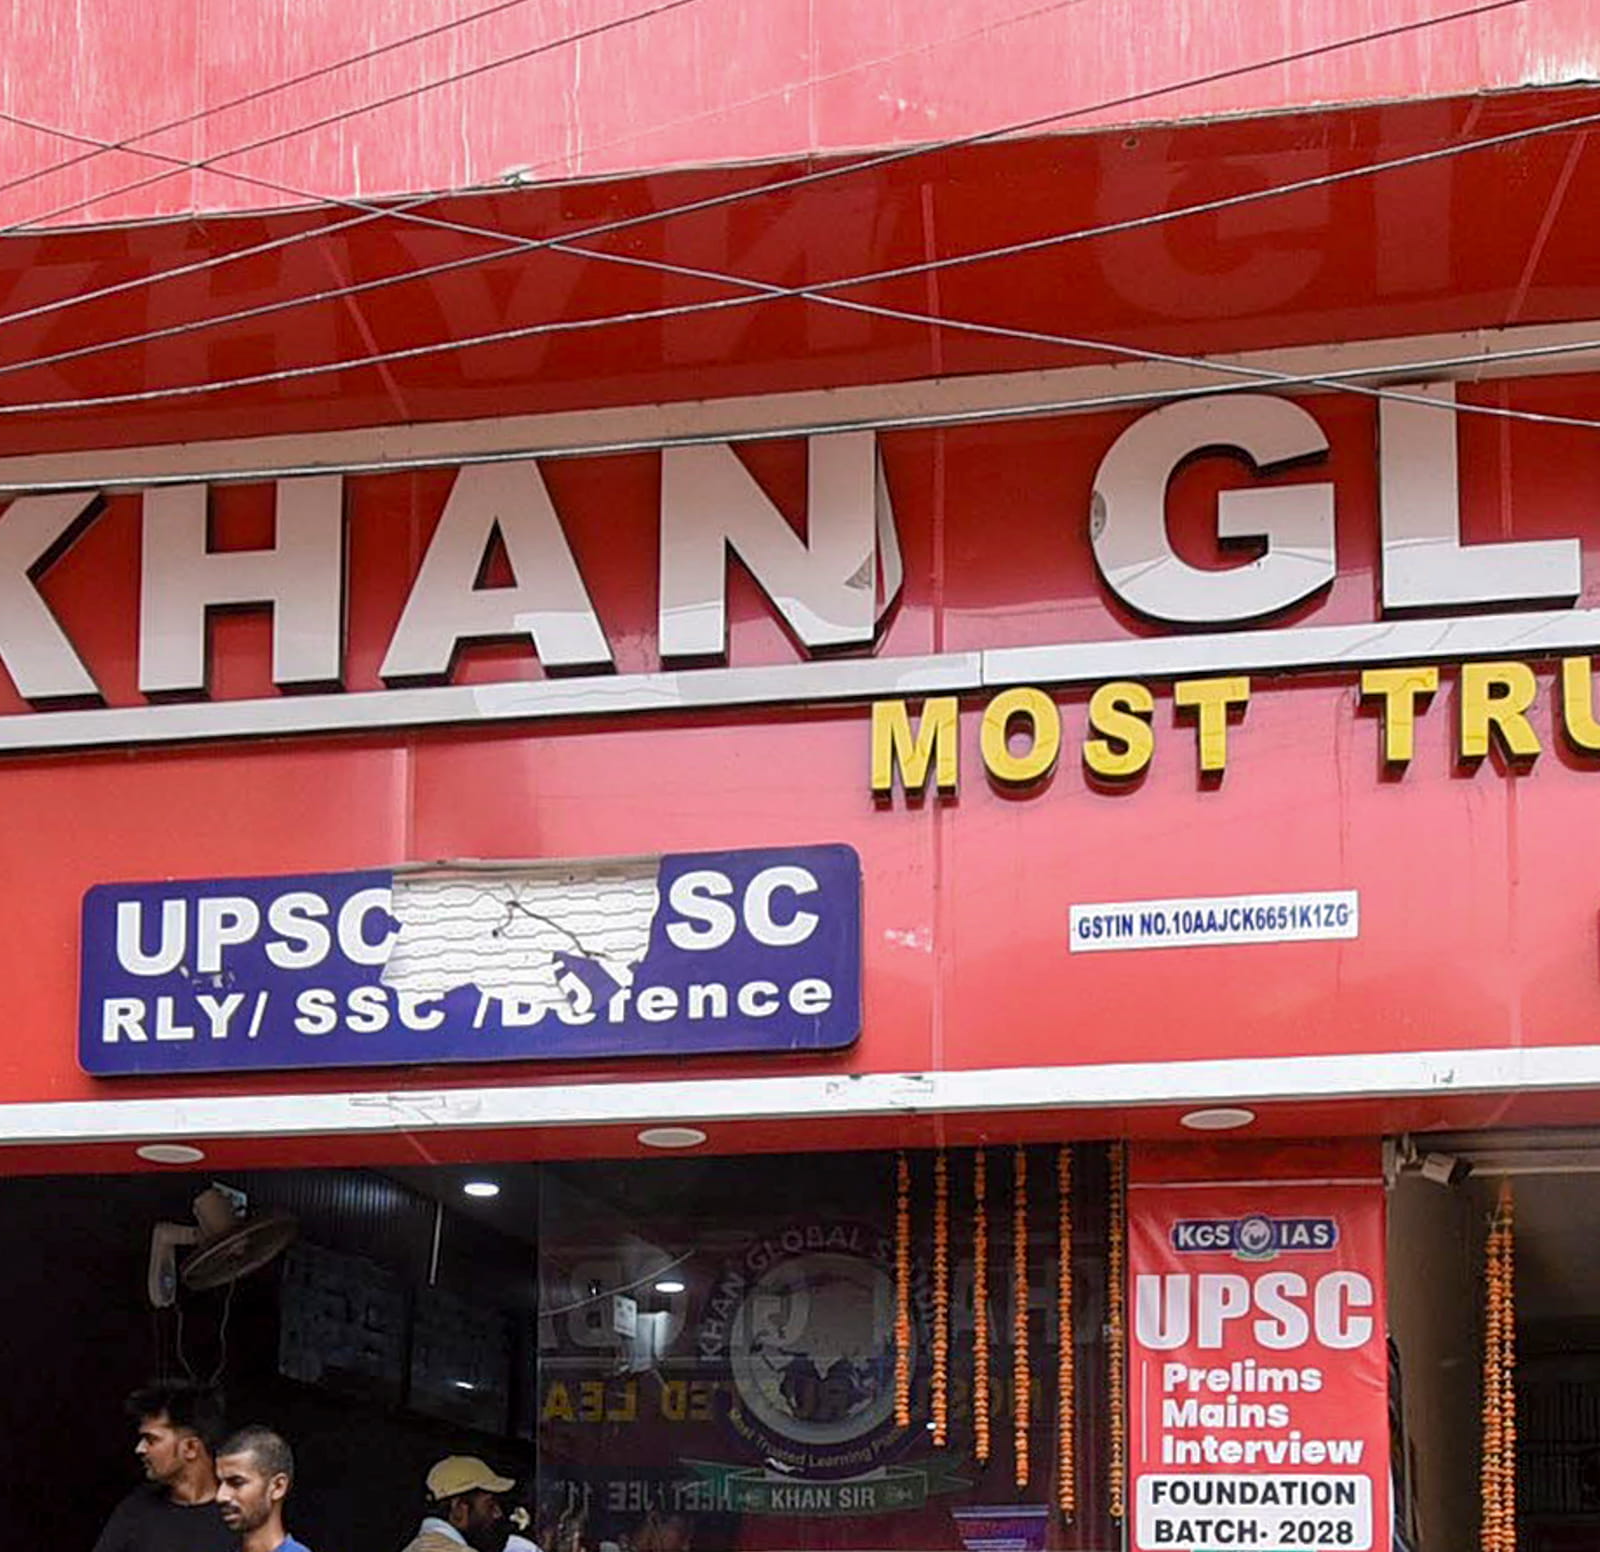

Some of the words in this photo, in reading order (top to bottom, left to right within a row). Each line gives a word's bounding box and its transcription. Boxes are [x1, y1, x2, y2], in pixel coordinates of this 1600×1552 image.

[870, 674, 1252, 792] MOST
[116, 887, 400, 976] UPSC
[665, 864, 821, 952] SC
[1078, 914, 1134, 939] GSTIN
[102, 991, 266, 1043] RLY/
[1178, 1225, 1231, 1248] KGS
[1280, 1221, 1330, 1246] IAS
[701, 1271, 746, 1362] KHAN
[746, 1225, 863, 1271] GLOBAL
[1135, 1271, 1374, 1350] UPSC
[1162, 1358, 1324, 1393] Prelims
[1162, 1395, 1289, 1429] Mains
[1162, 1432, 1365, 1466] Interview
[771, 1487, 831, 1510] KHAN
[838, 1486, 876, 1509] SIR
[1151, 1480, 1356, 1506] FOUNDATION
[1279, 1520, 1354, 1544] 2028
